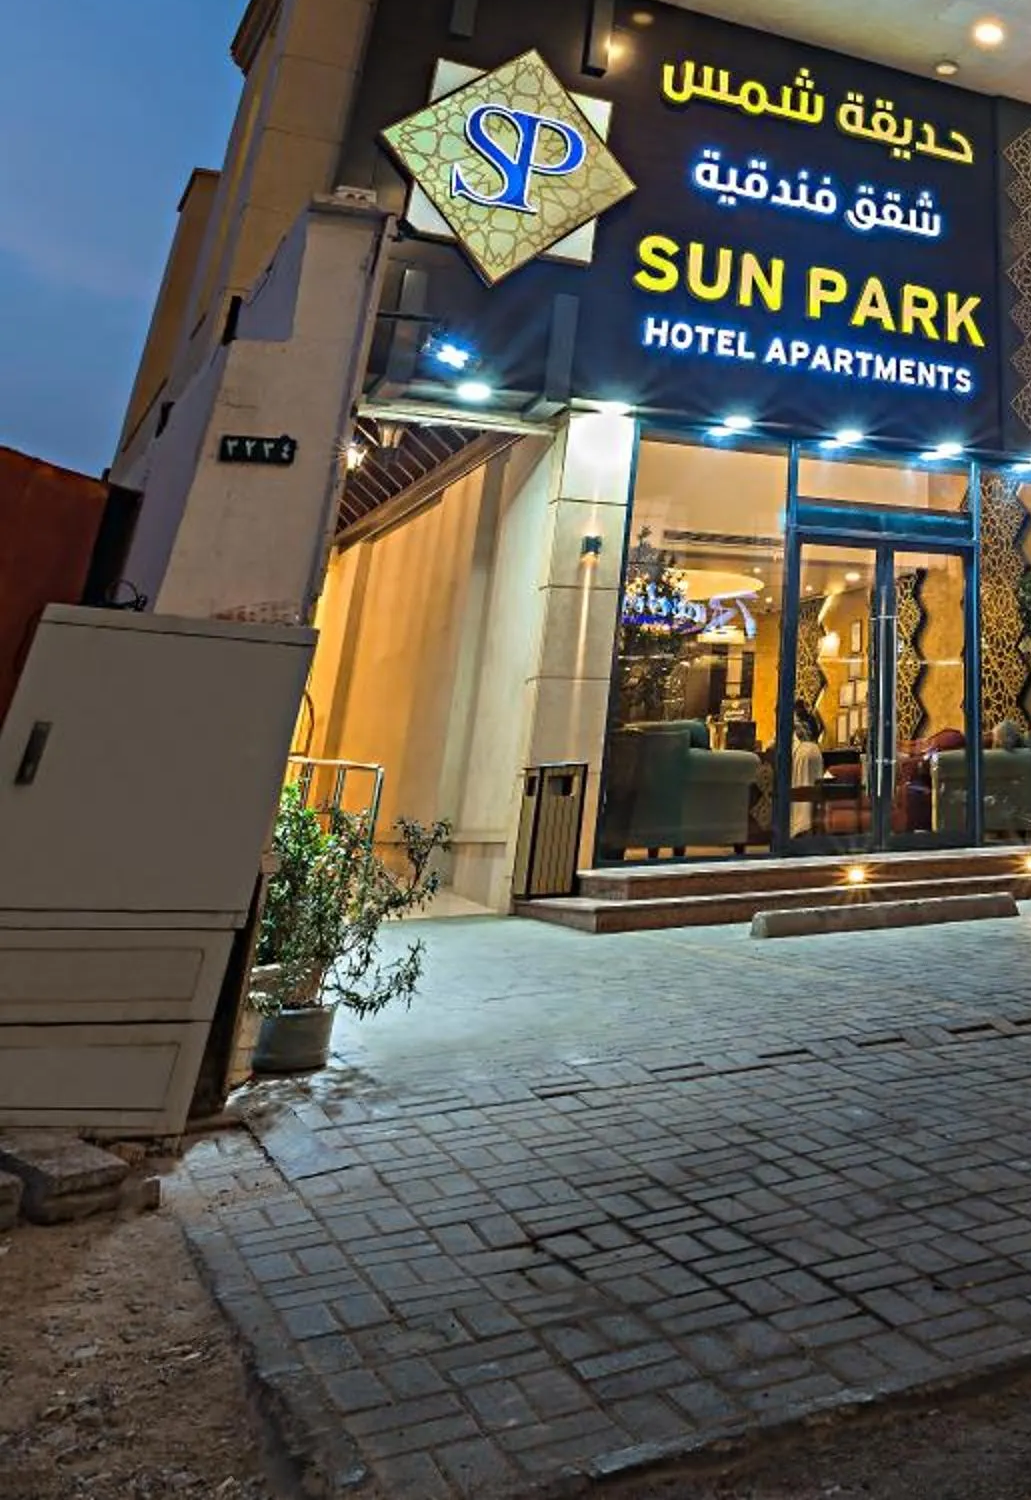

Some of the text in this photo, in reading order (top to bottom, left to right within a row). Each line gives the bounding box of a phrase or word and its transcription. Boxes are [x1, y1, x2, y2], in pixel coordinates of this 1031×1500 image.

[662, 60, 975, 165] حديقة شمس
[694, 148, 942, 238] شقق فندقية
[633, 234, 986, 348] SUN PARK
[643, 316, 973, 394] HOTEL APARTMENTS
